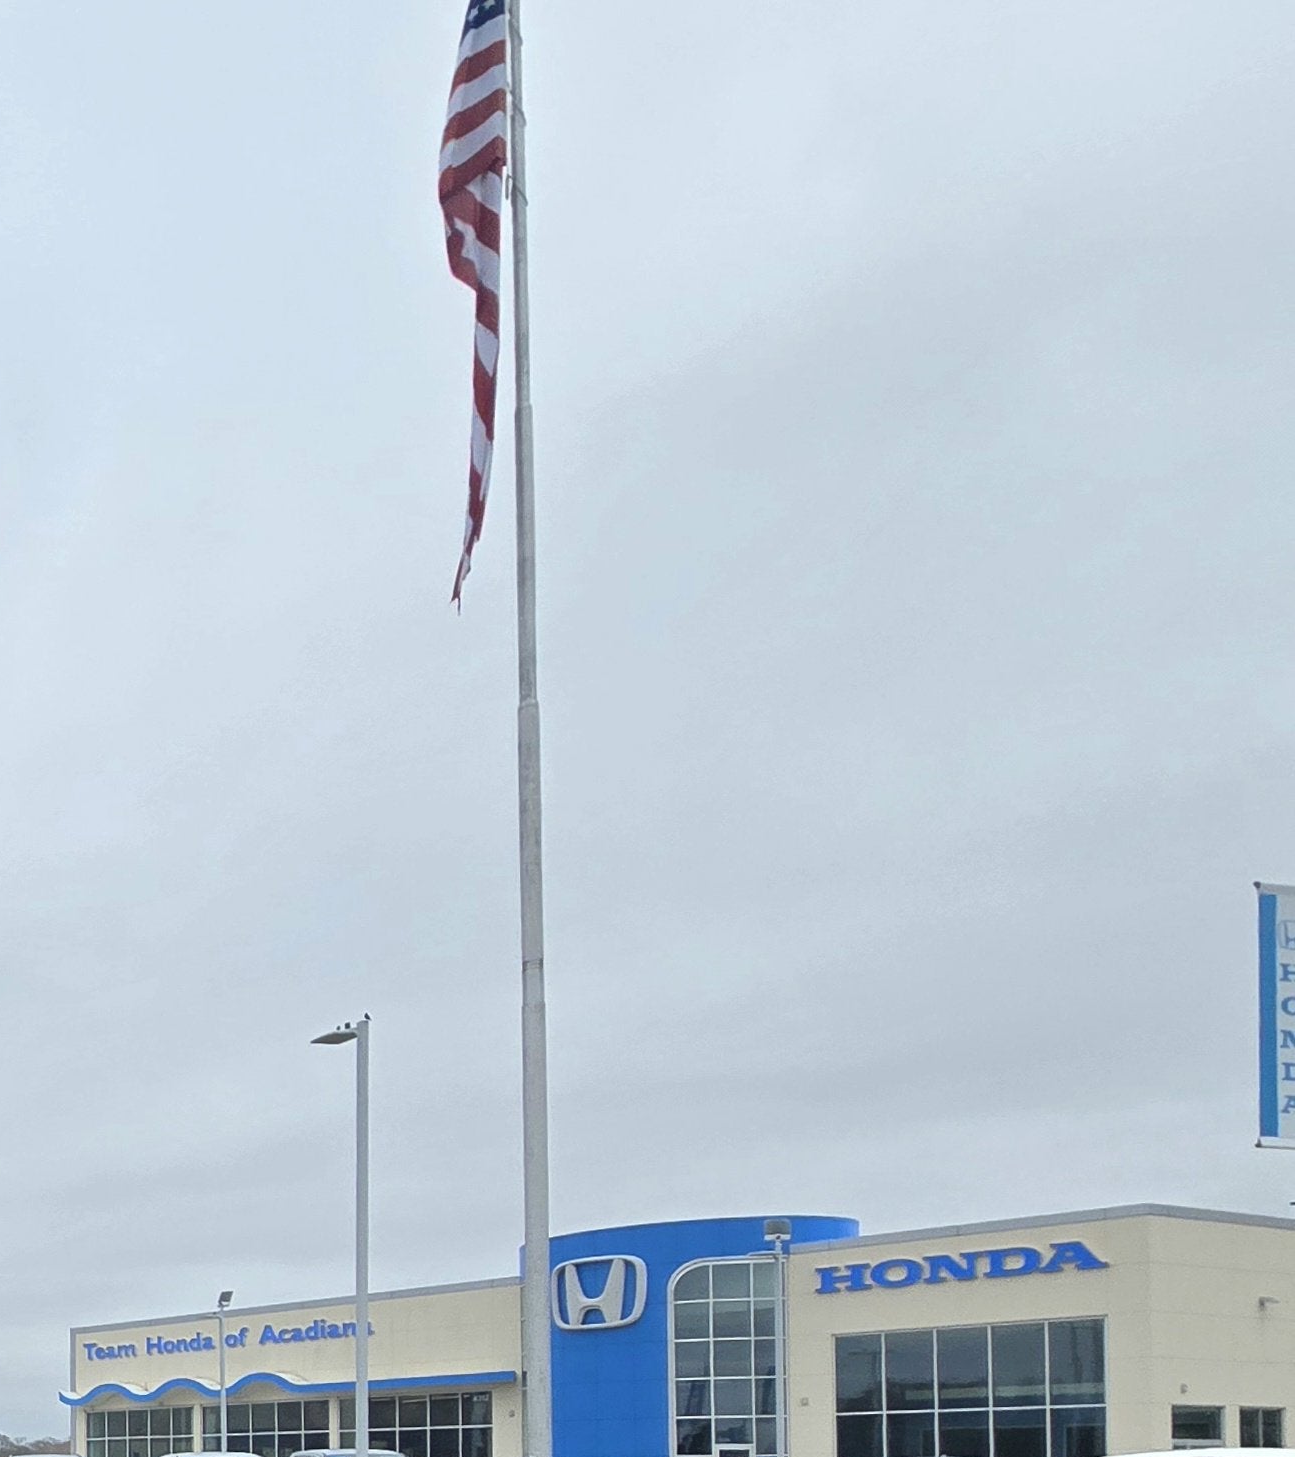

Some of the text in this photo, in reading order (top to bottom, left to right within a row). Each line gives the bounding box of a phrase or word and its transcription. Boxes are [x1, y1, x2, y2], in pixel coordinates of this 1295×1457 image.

[815, 1240, 1109, 1295] HONDA
[83, 1343, 137, 1362] Team
[146, 1332, 216, 1355] Honda
[224, 1327, 249, 1348] of
